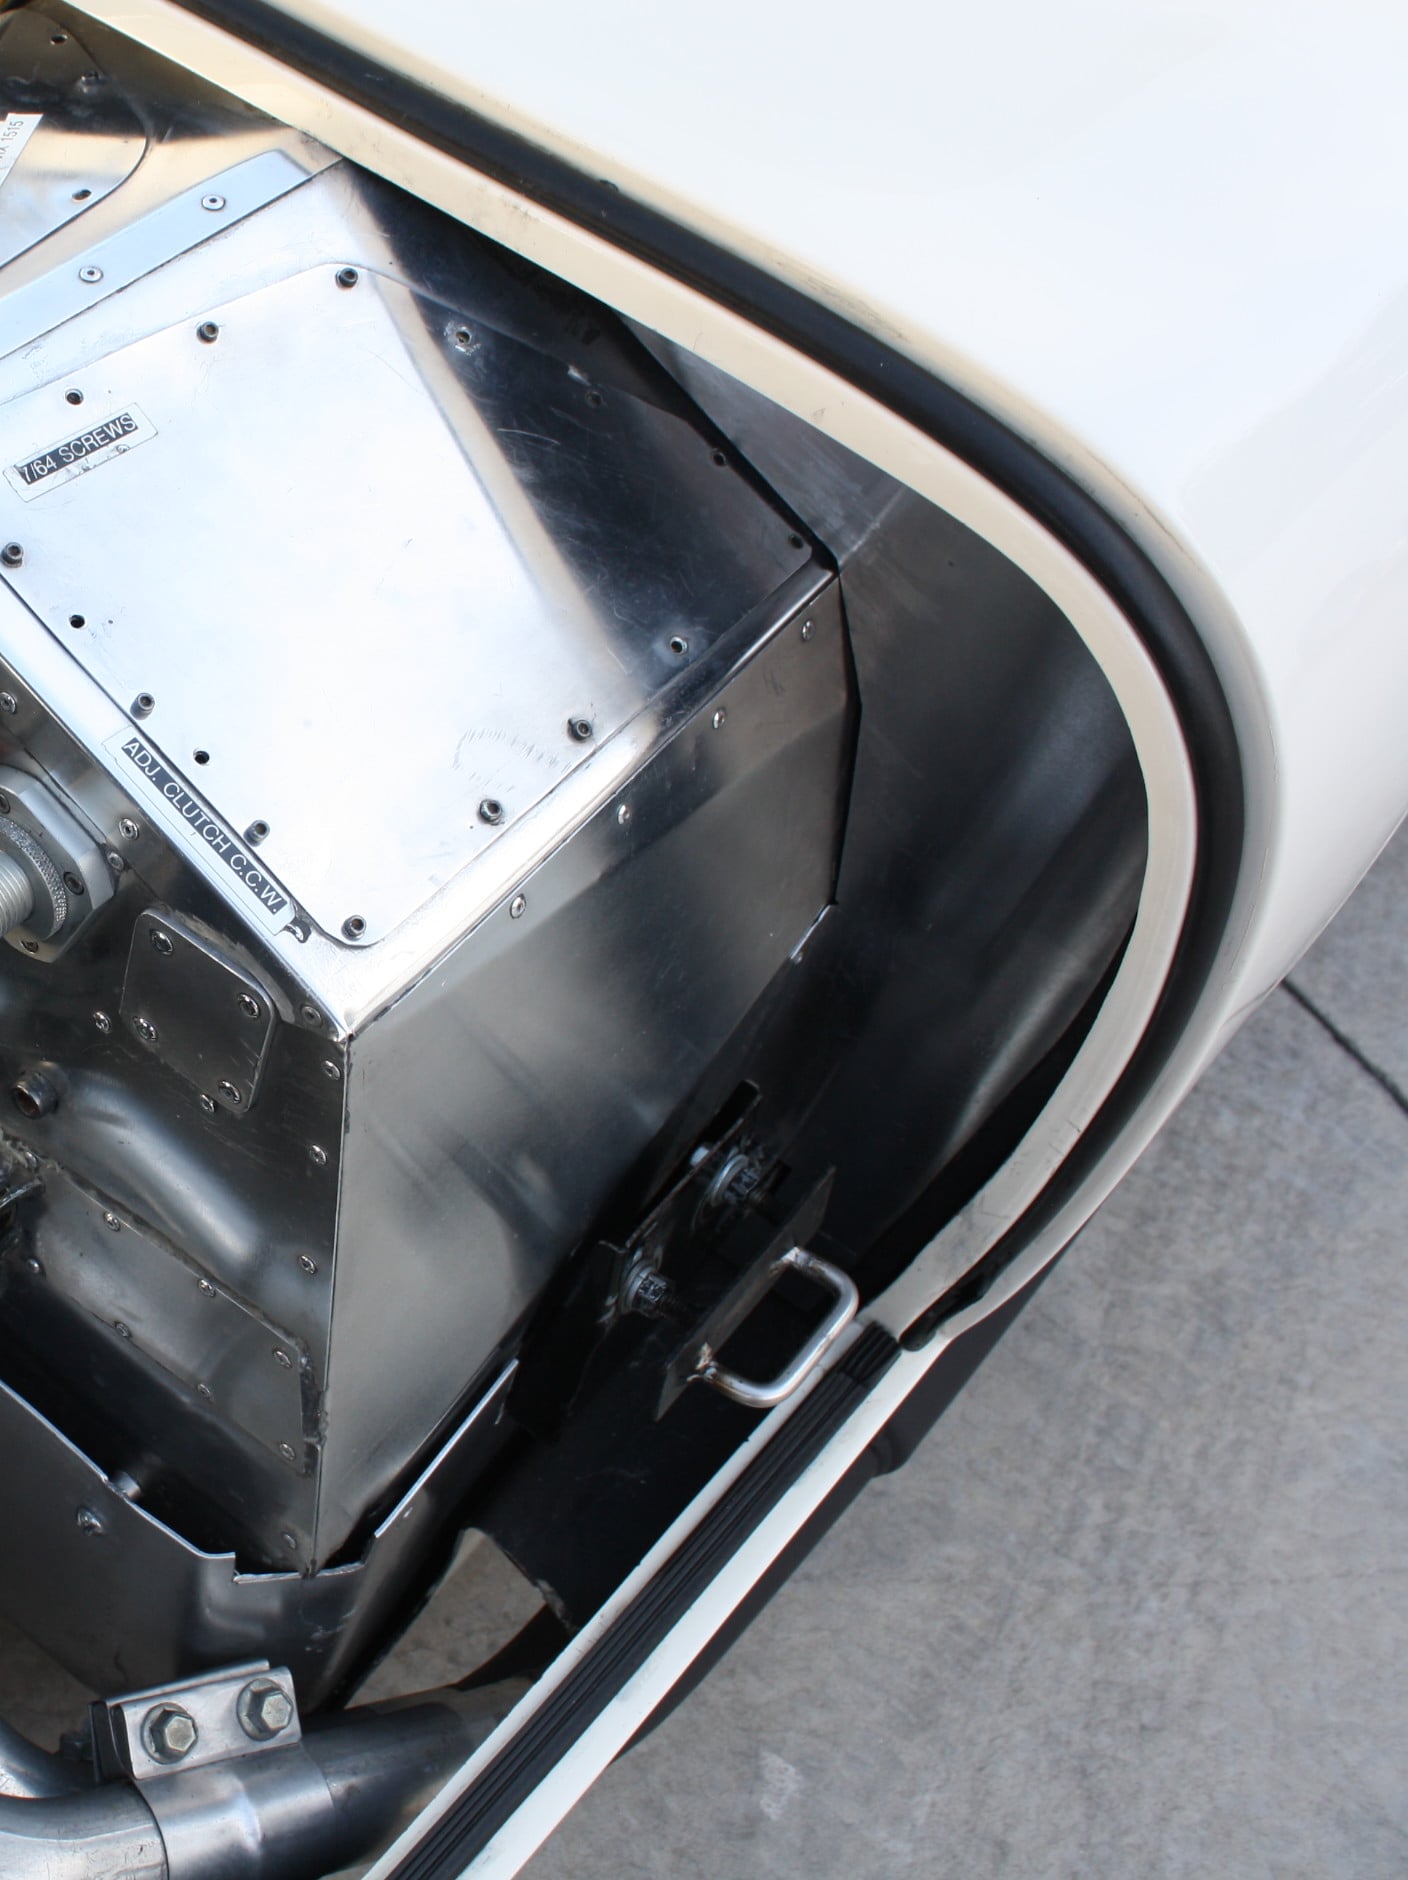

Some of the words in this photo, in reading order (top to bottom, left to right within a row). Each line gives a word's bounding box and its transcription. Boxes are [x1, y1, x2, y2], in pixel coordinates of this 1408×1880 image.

[1, 120, 24, 142] 1515
[21, 455, 58, 483] 7/64
[58, 415, 137, 463] SCREWS
[123, 741, 161, 781] ADJ.
[163, 782, 232, 853] CLUTCH
[230, 855, 282, 913] C.C.W.
